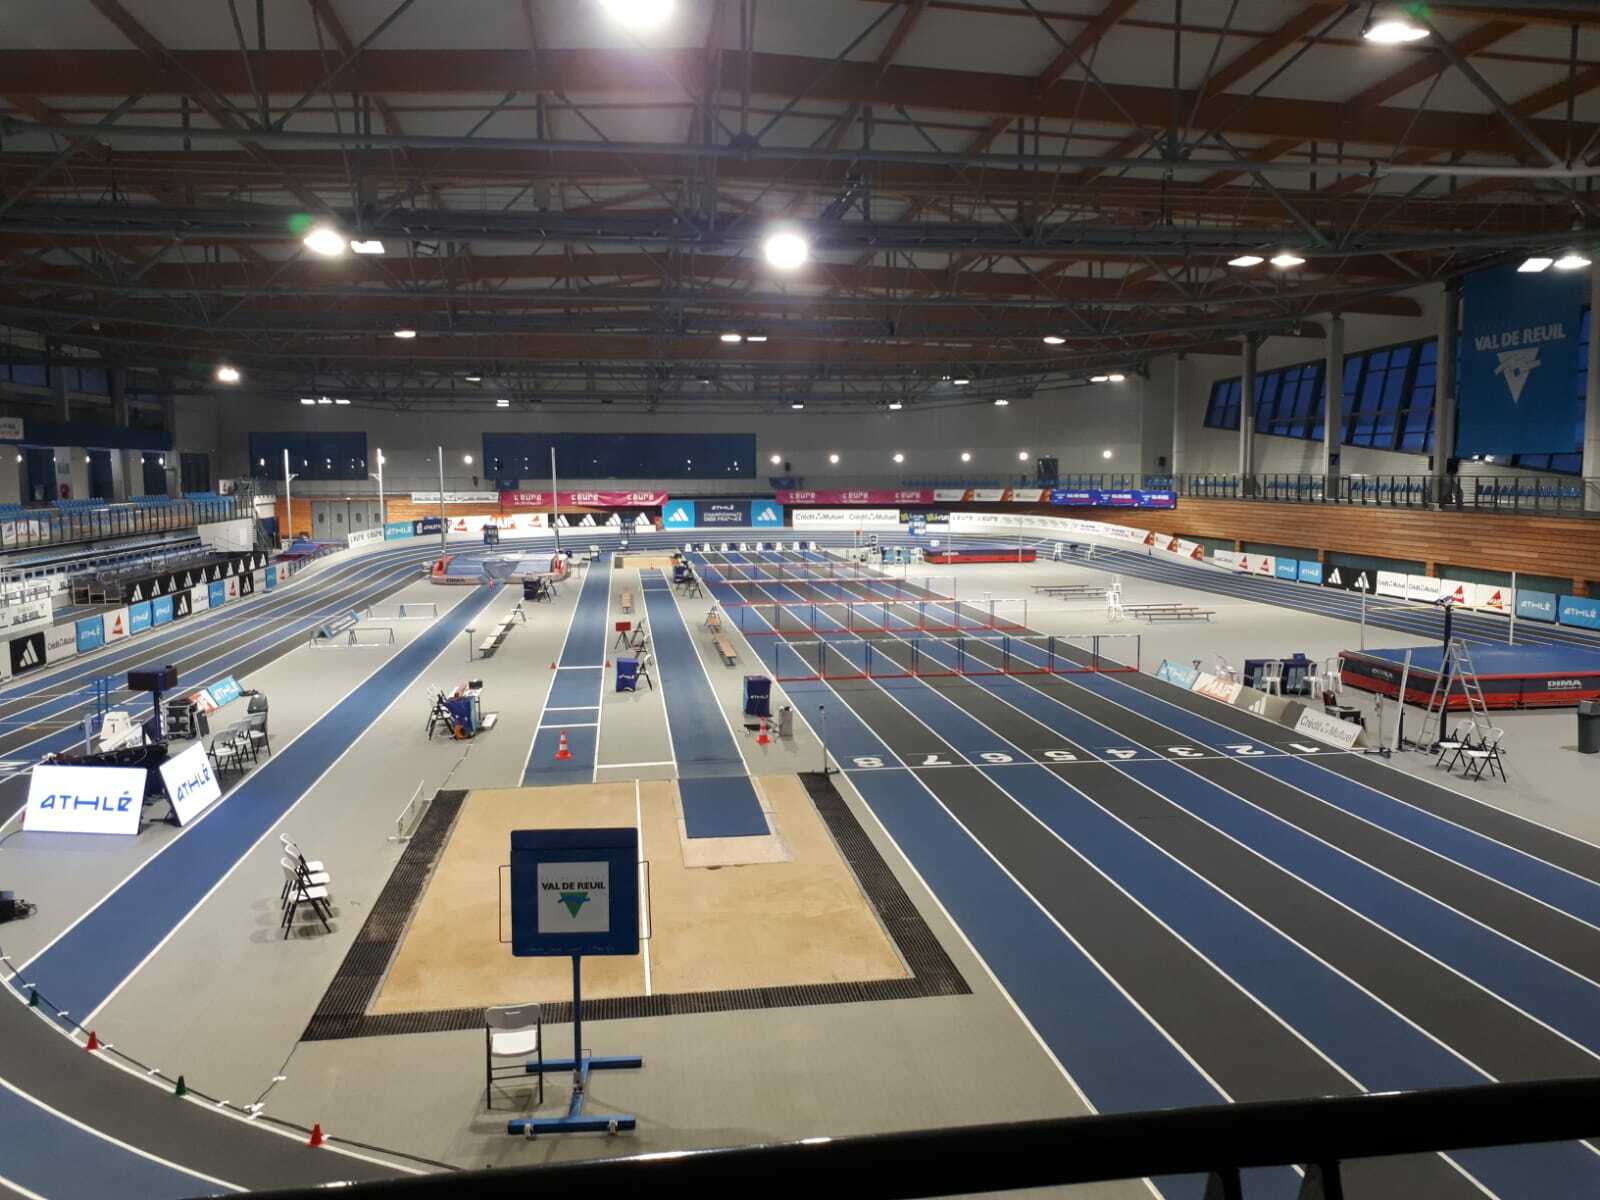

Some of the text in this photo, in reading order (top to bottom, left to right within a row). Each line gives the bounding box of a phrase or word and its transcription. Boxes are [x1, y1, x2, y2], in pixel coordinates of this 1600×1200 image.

[1474, 323, 1567, 351] VAL DE REUIL
[1547, 680, 1582, 689] DIMA
[1106, 748, 1138, 759] 4
[1168, 747, 1205, 757] 3
[1225, 745, 1266, 755] 2
[1289, 743, 1321, 753] 1
[923, 755, 952, 766] 7
[980, 752, 1013, 763] 6
[1044, 751, 1078, 761] 5
[853, 757, 884, 768] 8
[178, 763, 210, 802] ATHLÉ
[40, 791, 132, 811] ATHLÉ
[542, 881, 606, 890] VAL DE REUIL
